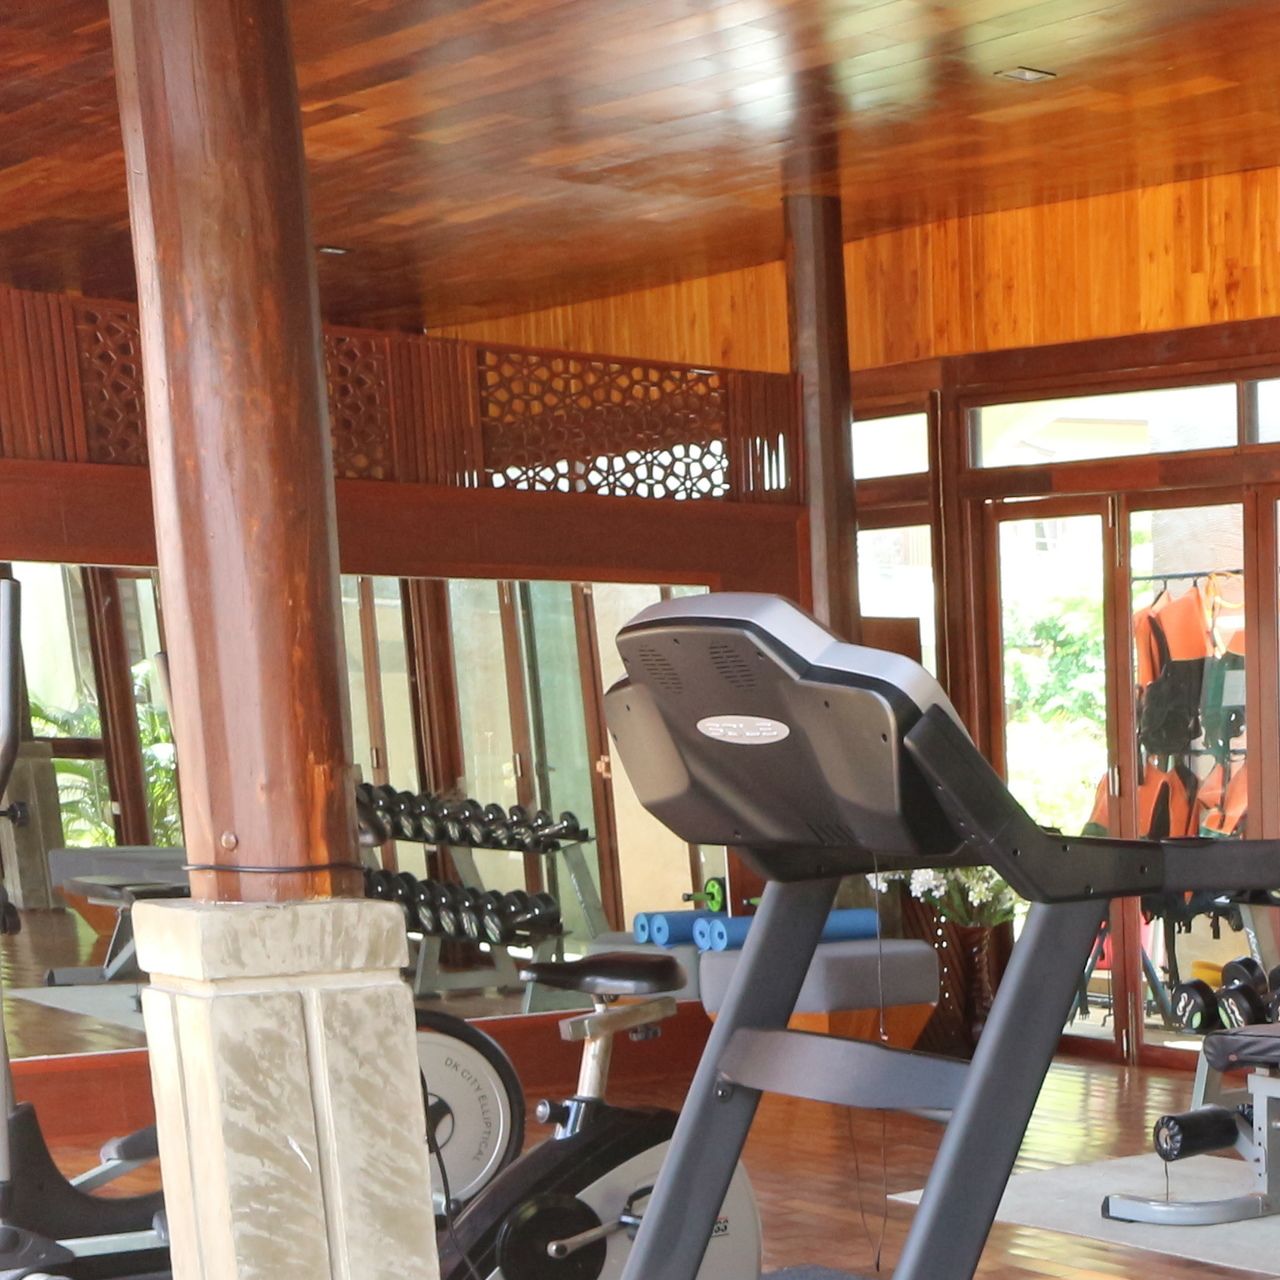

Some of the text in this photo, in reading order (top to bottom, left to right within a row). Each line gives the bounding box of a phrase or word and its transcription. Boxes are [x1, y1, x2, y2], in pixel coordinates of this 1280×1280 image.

[444, 1057, 492, 1161] DK CITY ELLIPTICAL
